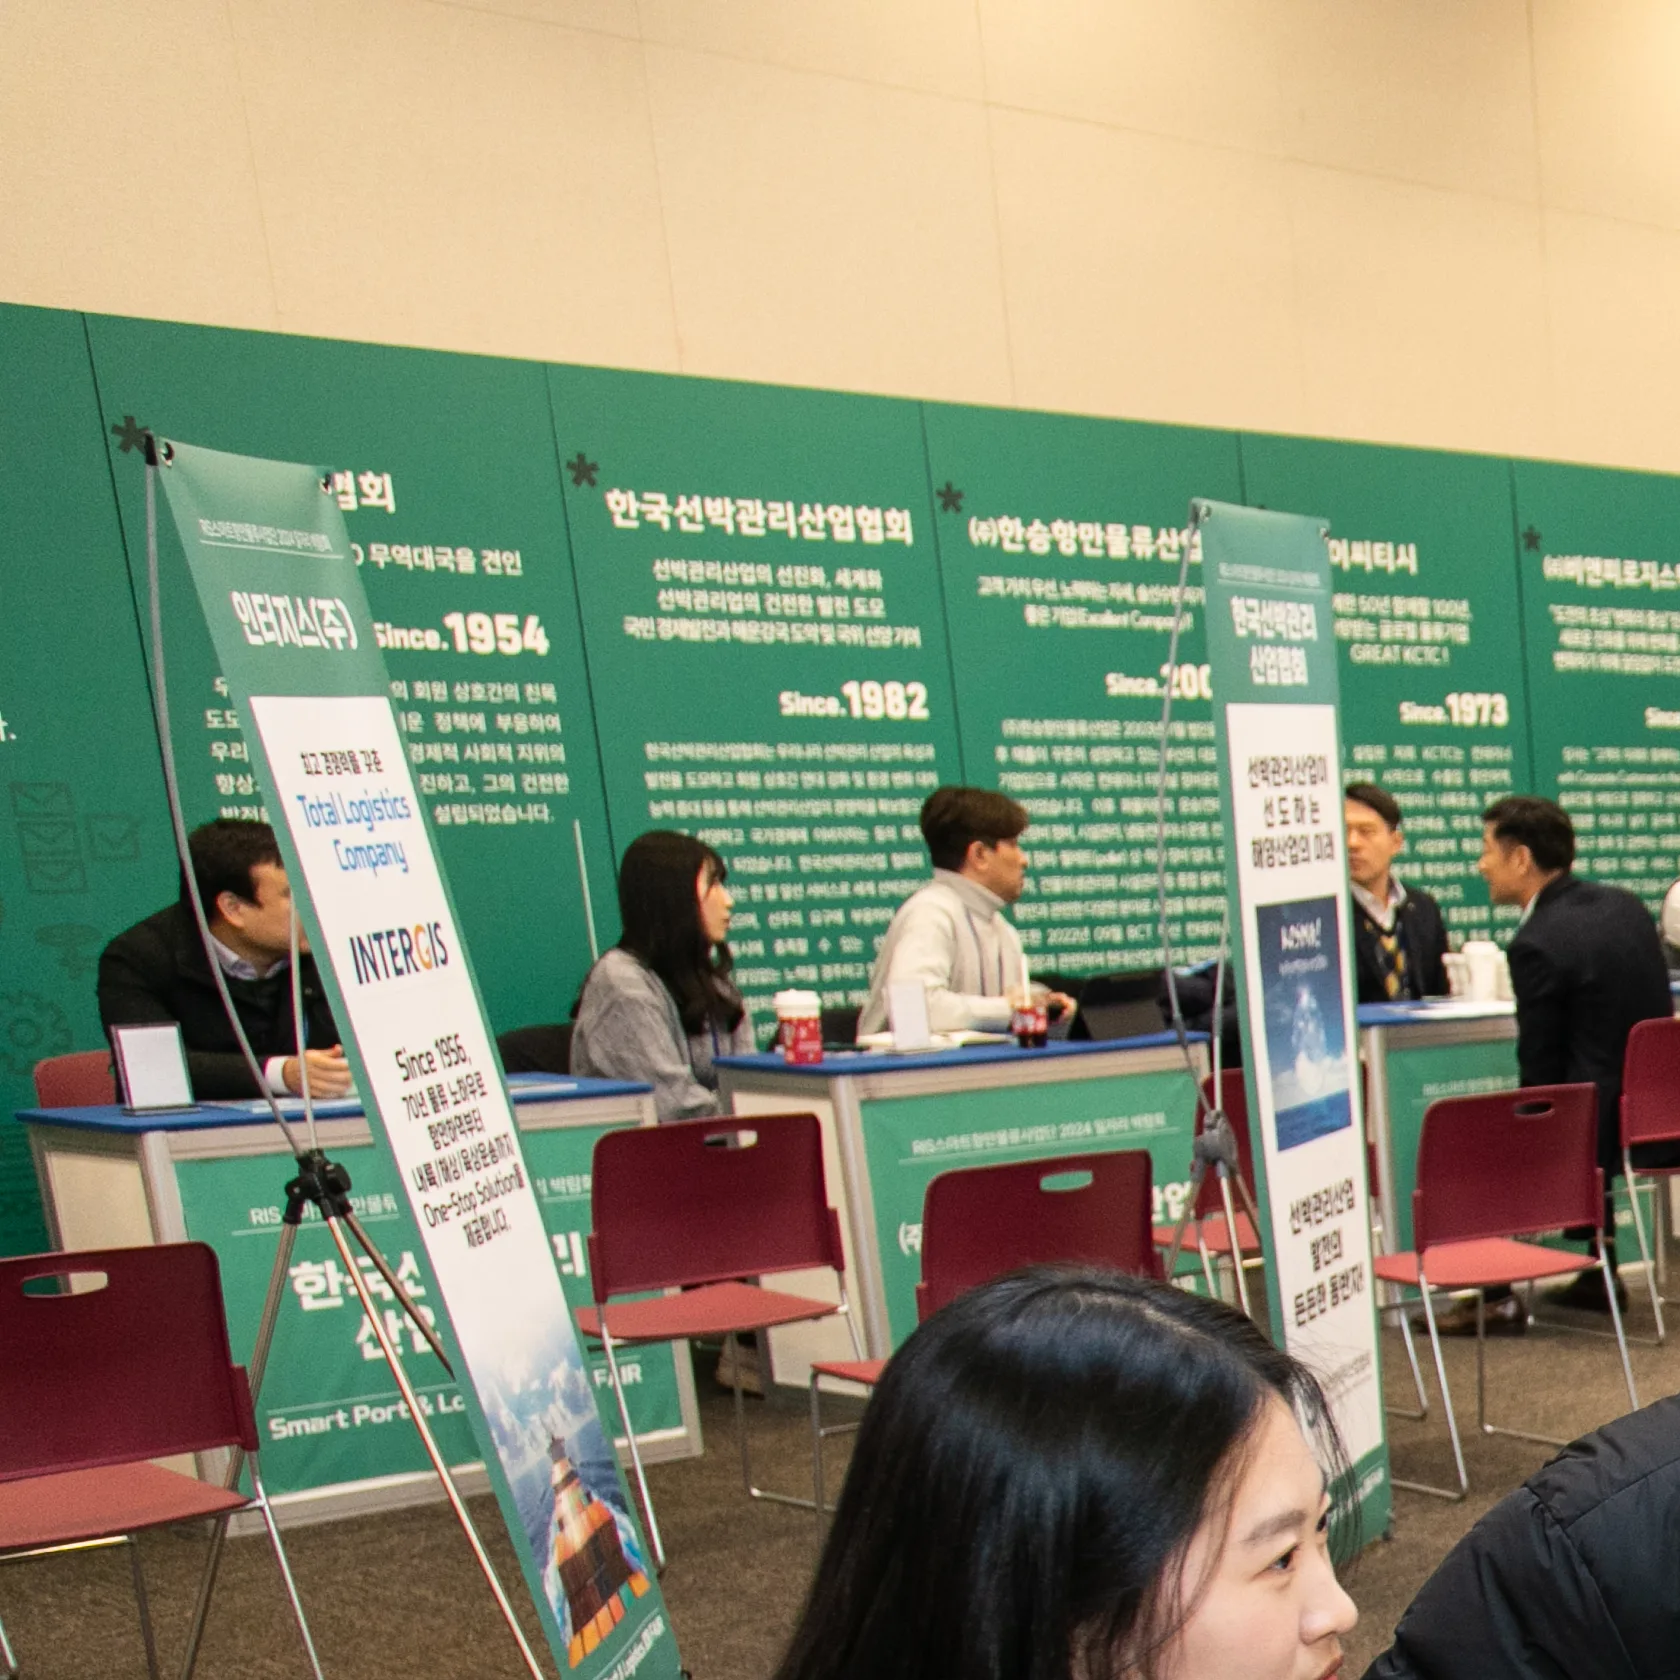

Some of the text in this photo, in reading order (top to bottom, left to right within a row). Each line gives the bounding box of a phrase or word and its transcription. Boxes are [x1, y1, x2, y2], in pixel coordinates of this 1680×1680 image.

[605, 487, 913, 547] 한국선박관리산업협회
[369, 543, 523, 576] 무역대국을 견인
[653, 558, 883, 592] 선박관리산업의 선진화, 세계화
[230, 590, 358, 650] 인터지스(주)
[657, 588, 886, 619] 선박관리업의 건전한 발전 도모
[1230, 595, 1318, 642] 한국선박관리
[1250, 644, 1308, 686] 산업협회
[1350, 644, 1401, 665] GREAT
[1402, 645, 1440, 666] KCTC
[412, 680, 557, 705] 회원 상호간의 친목
[778, 680, 930, 721] Since.1982
[1399, 692, 1510, 728] Since.1973
[434, 712, 486, 733] 정책에
[496, 713, 562, 734] 부응하여
[409, 742, 566, 764] 경제적 사회적 지위의
[1247, 754, 1329, 789] 선박관리산업이
[420, 773, 476, 795] 진하고,
[521, 773, 570, 795] 건전한
[296, 788, 412, 833] Total Logistics
[434, 803, 555, 825] 설립되었습니다.
[333, 838, 409, 877] Company
[1252, 831, 1335, 870] 해양산업의 미래
[349, 921, 449, 985] INTERGIS
[395, 1033, 472, 1082] Since 1956,
[402, 1071, 488, 1122] 70년 물류 노하우로
[428, 1109, 487, 1151] 항만하역부터
[1059, 1121, 1093, 1138] 2024
[412, 1132, 516, 1192] 내륙/해상/육상운송까지
[423, 1161, 526, 1228] One-Stop Solution을
[1289, 1175, 1356, 1236] 선박관리산업
[463, 1210, 512, 1249] 제공합니다.
[1310, 1227, 1344, 1272] 발전의
[1293, 1267, 1365, 1327] 든든한 동반자!
[268, 1412, 349, 1441] Smart
[352, 1399, 410, 1426] Port
